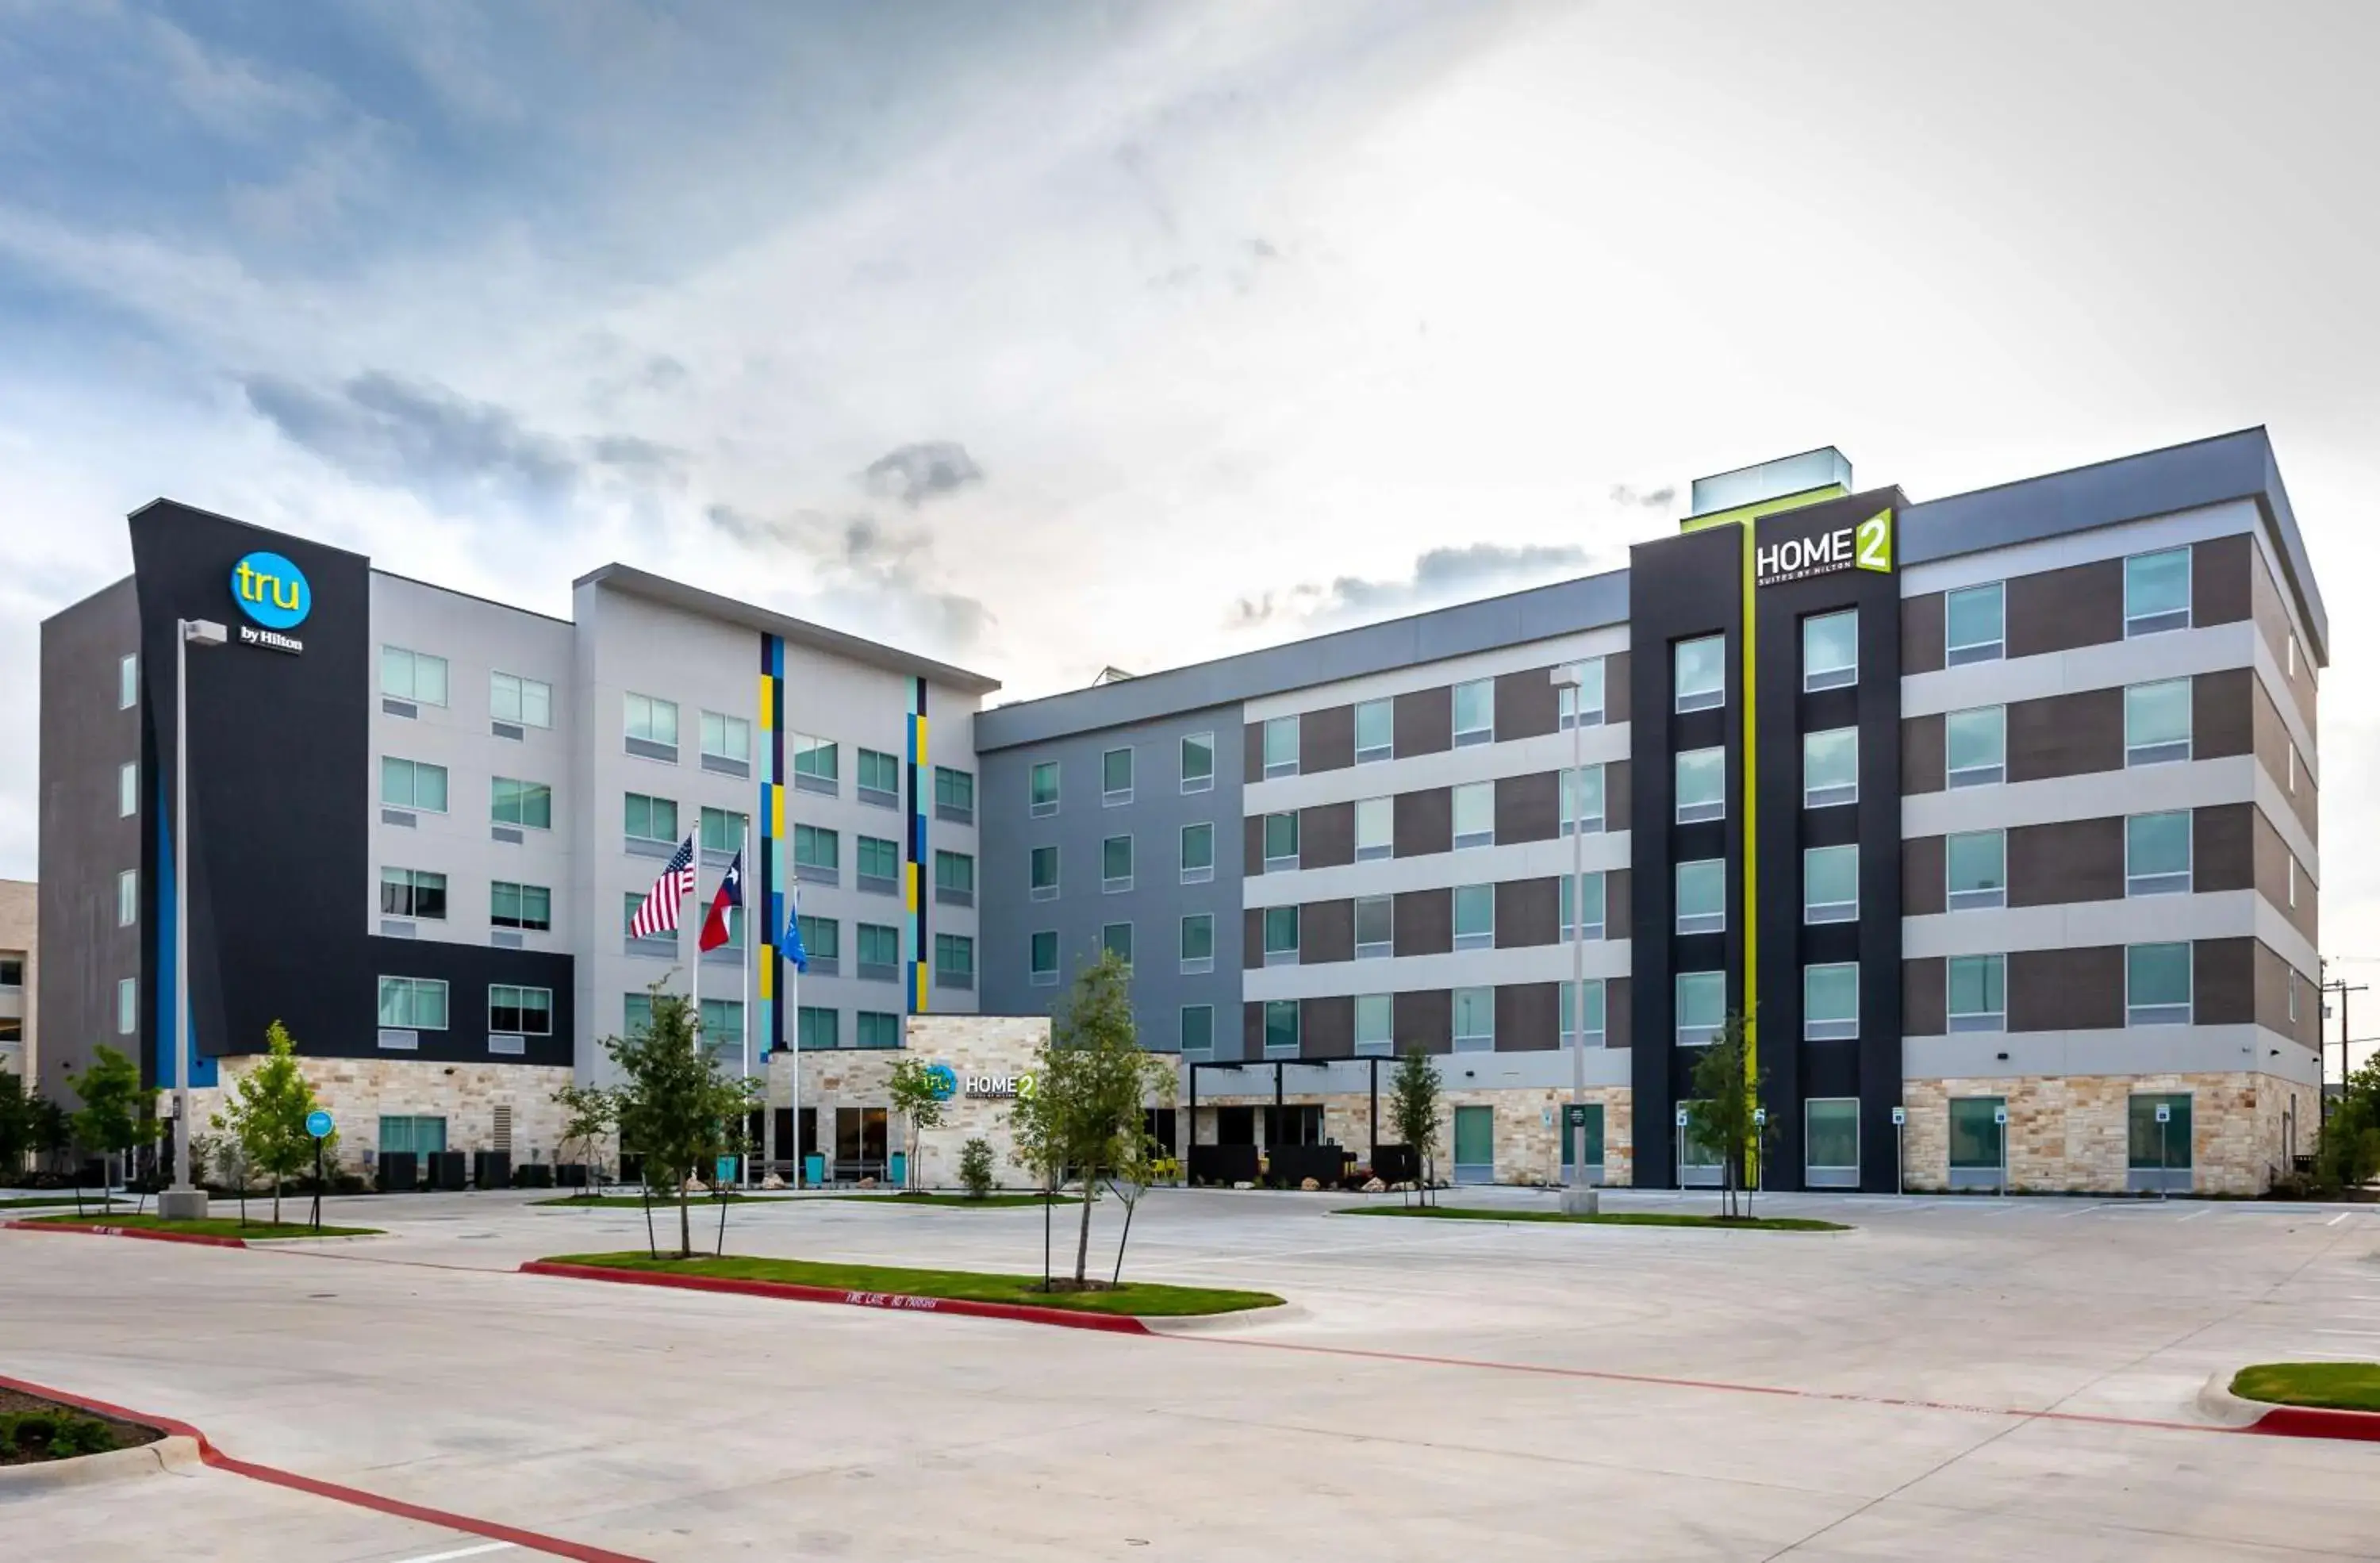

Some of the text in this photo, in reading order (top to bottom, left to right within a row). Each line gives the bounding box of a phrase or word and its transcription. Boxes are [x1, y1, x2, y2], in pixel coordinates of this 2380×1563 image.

[236, 561, 299, 610] tru
[1758, 561, 1852, 586] SUITES BY HILTON
[241, 626, 302, 651] by Hilton
